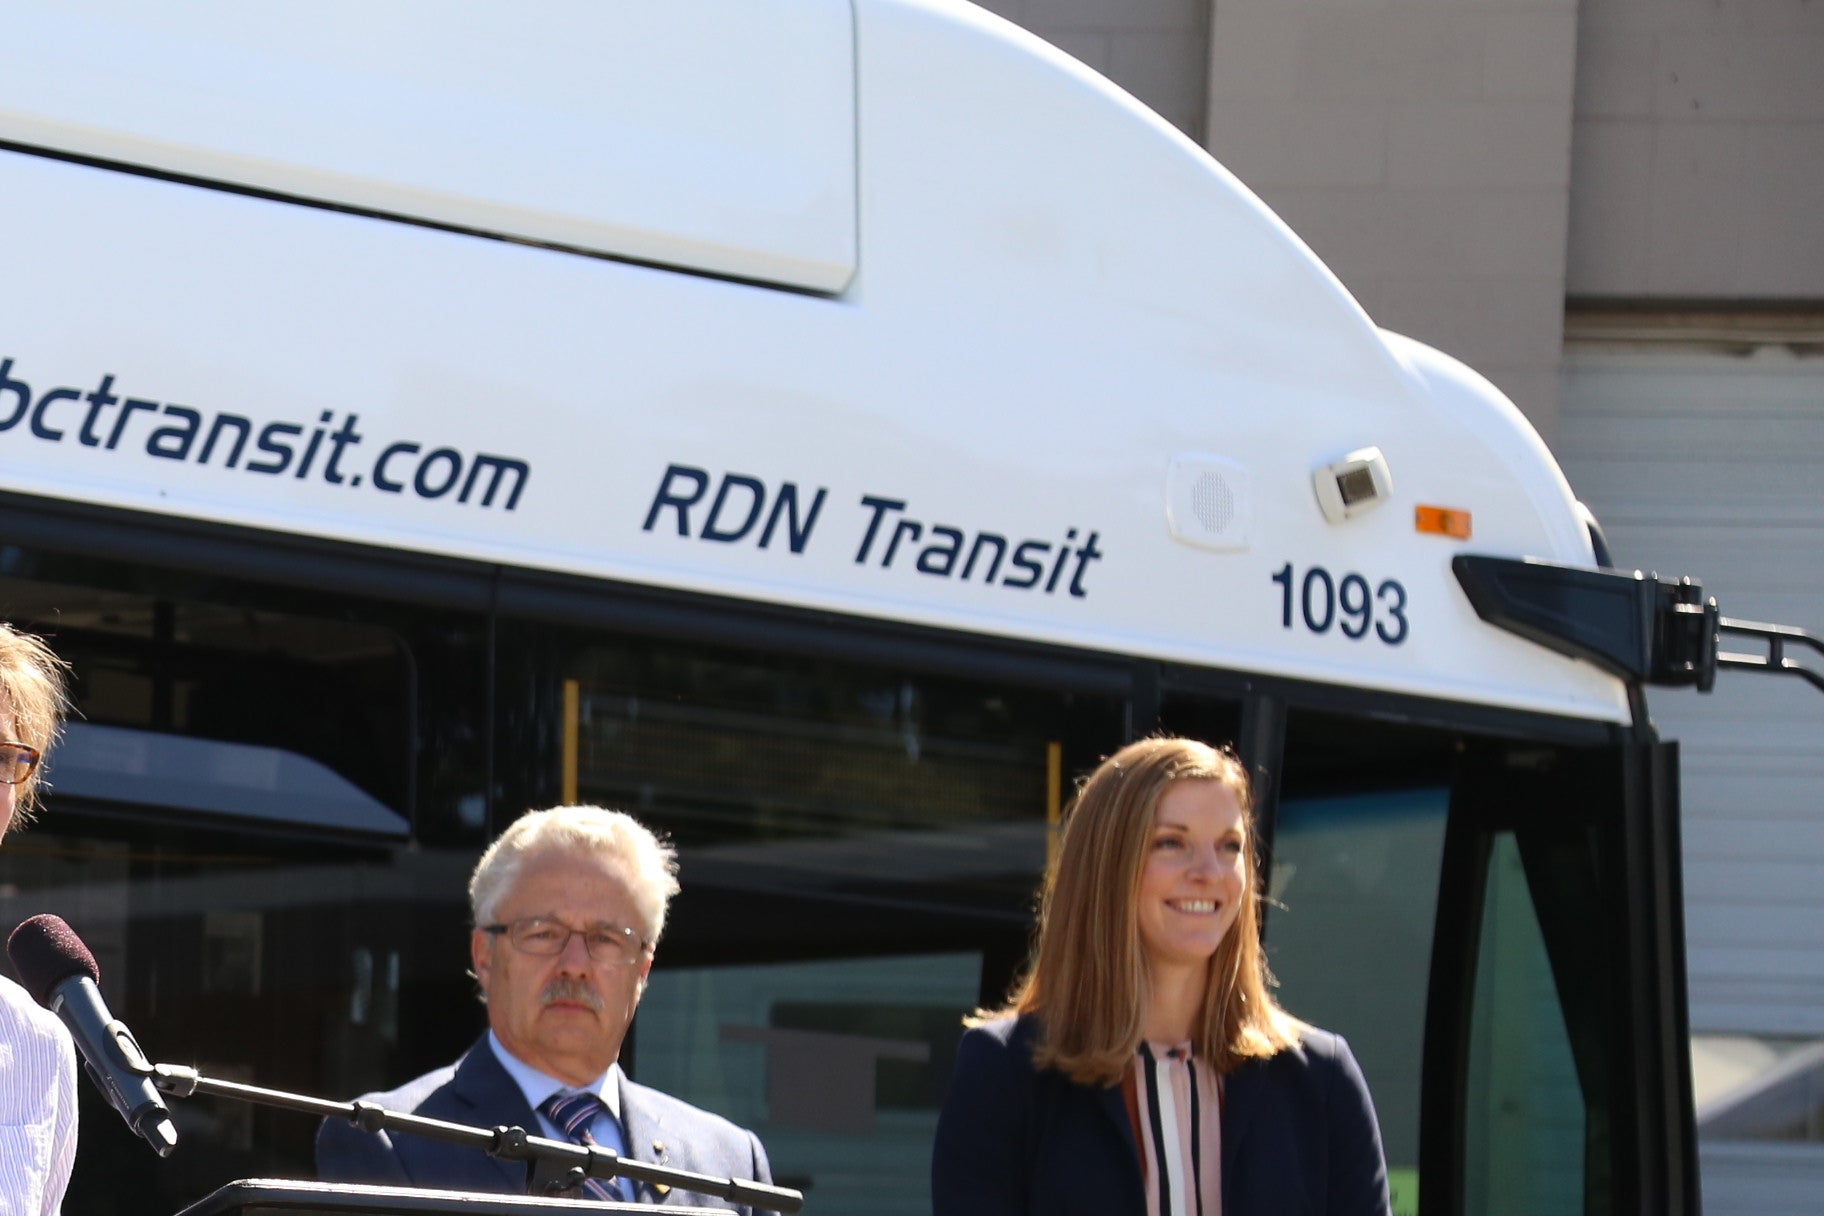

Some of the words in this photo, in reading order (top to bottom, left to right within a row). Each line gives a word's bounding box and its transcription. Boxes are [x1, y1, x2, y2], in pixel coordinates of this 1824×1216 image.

[642, 463, 828, 555] RDN
[853, 494, 1103, 598] Transit
[1271, 561, 1411, 647] 1093
